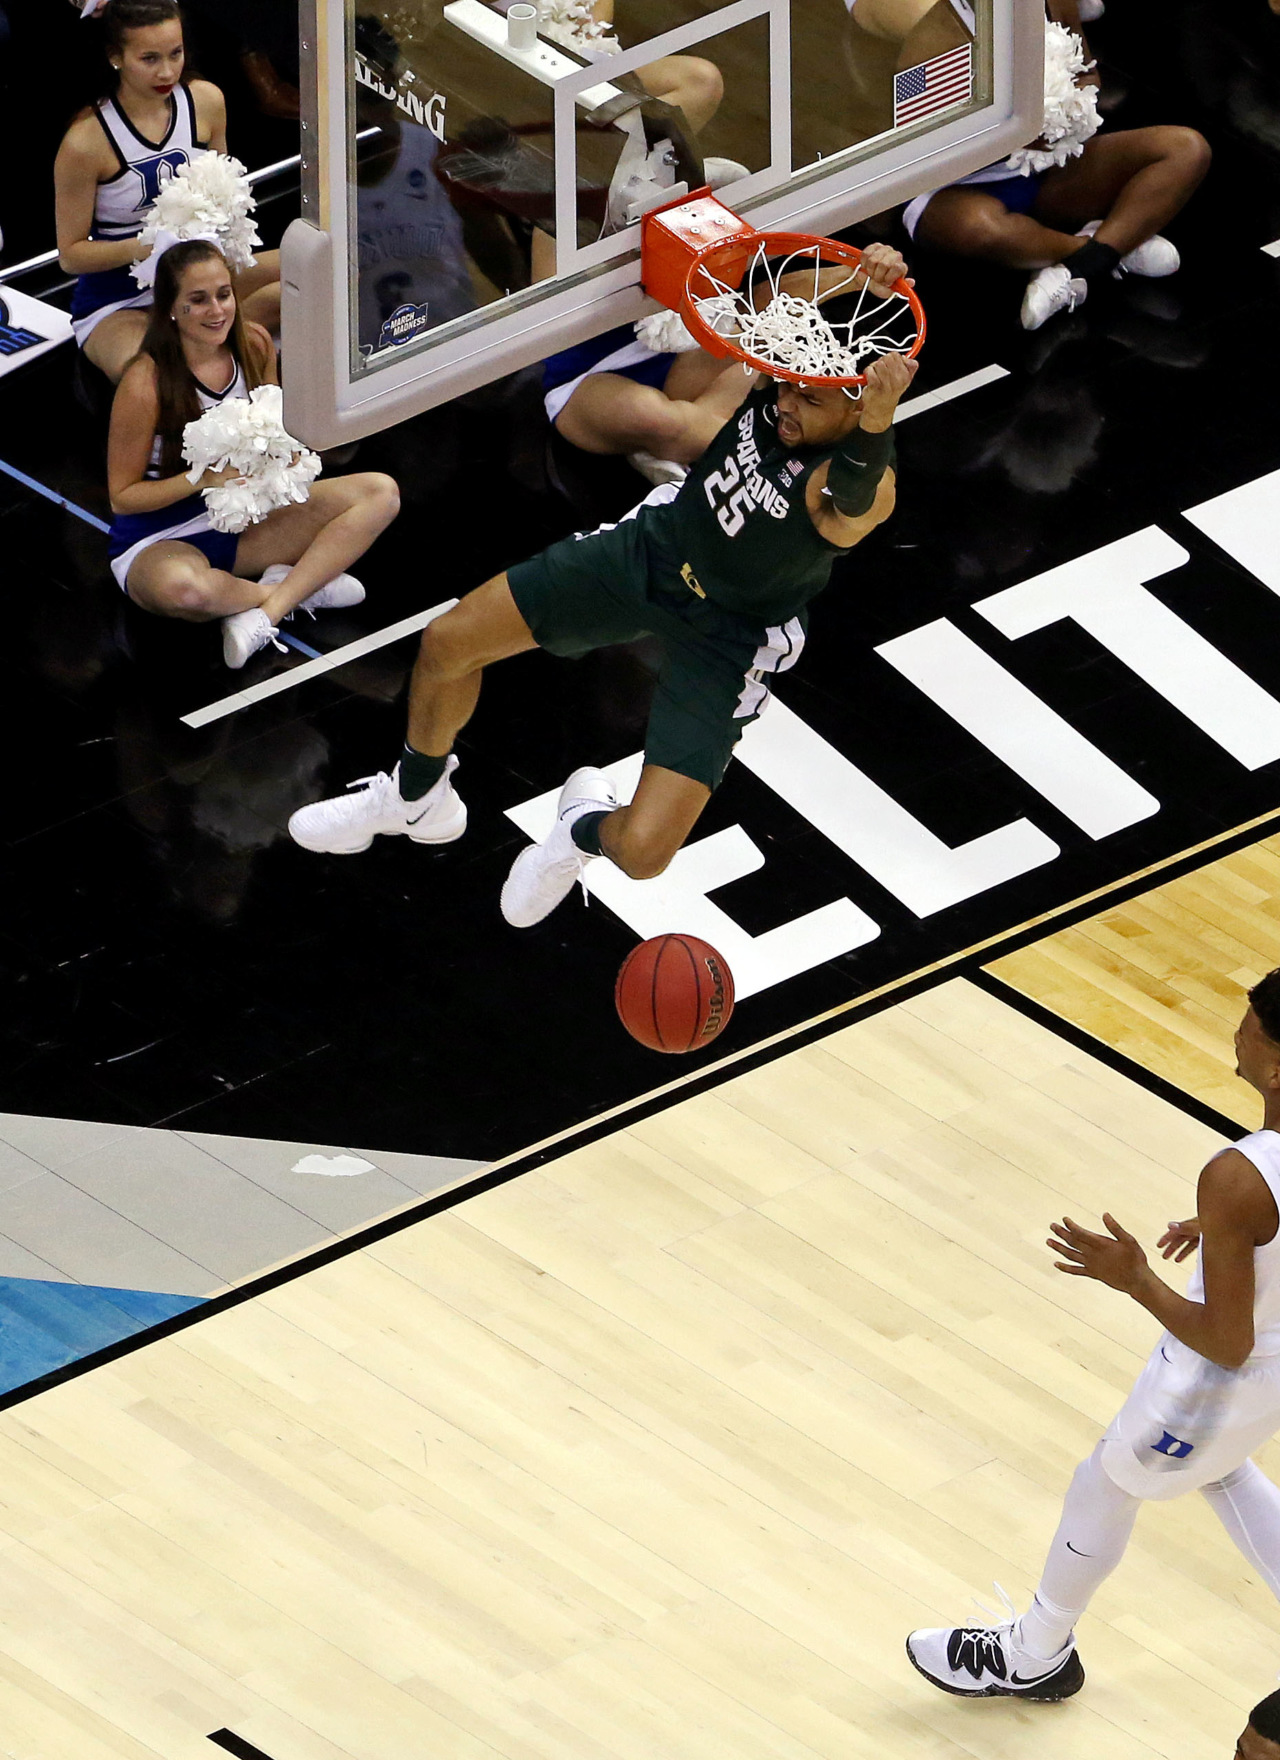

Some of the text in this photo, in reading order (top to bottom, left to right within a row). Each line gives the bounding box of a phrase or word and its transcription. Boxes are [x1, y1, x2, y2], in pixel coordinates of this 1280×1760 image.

[390, 311, 416, 330] MARCH
[393, 315, 427, 337] MADNESS
[703, 455, 757, 537] 25
[738, 407, 790, 519] SPARTANS
[700, 955, 724, 1038] Wilson
